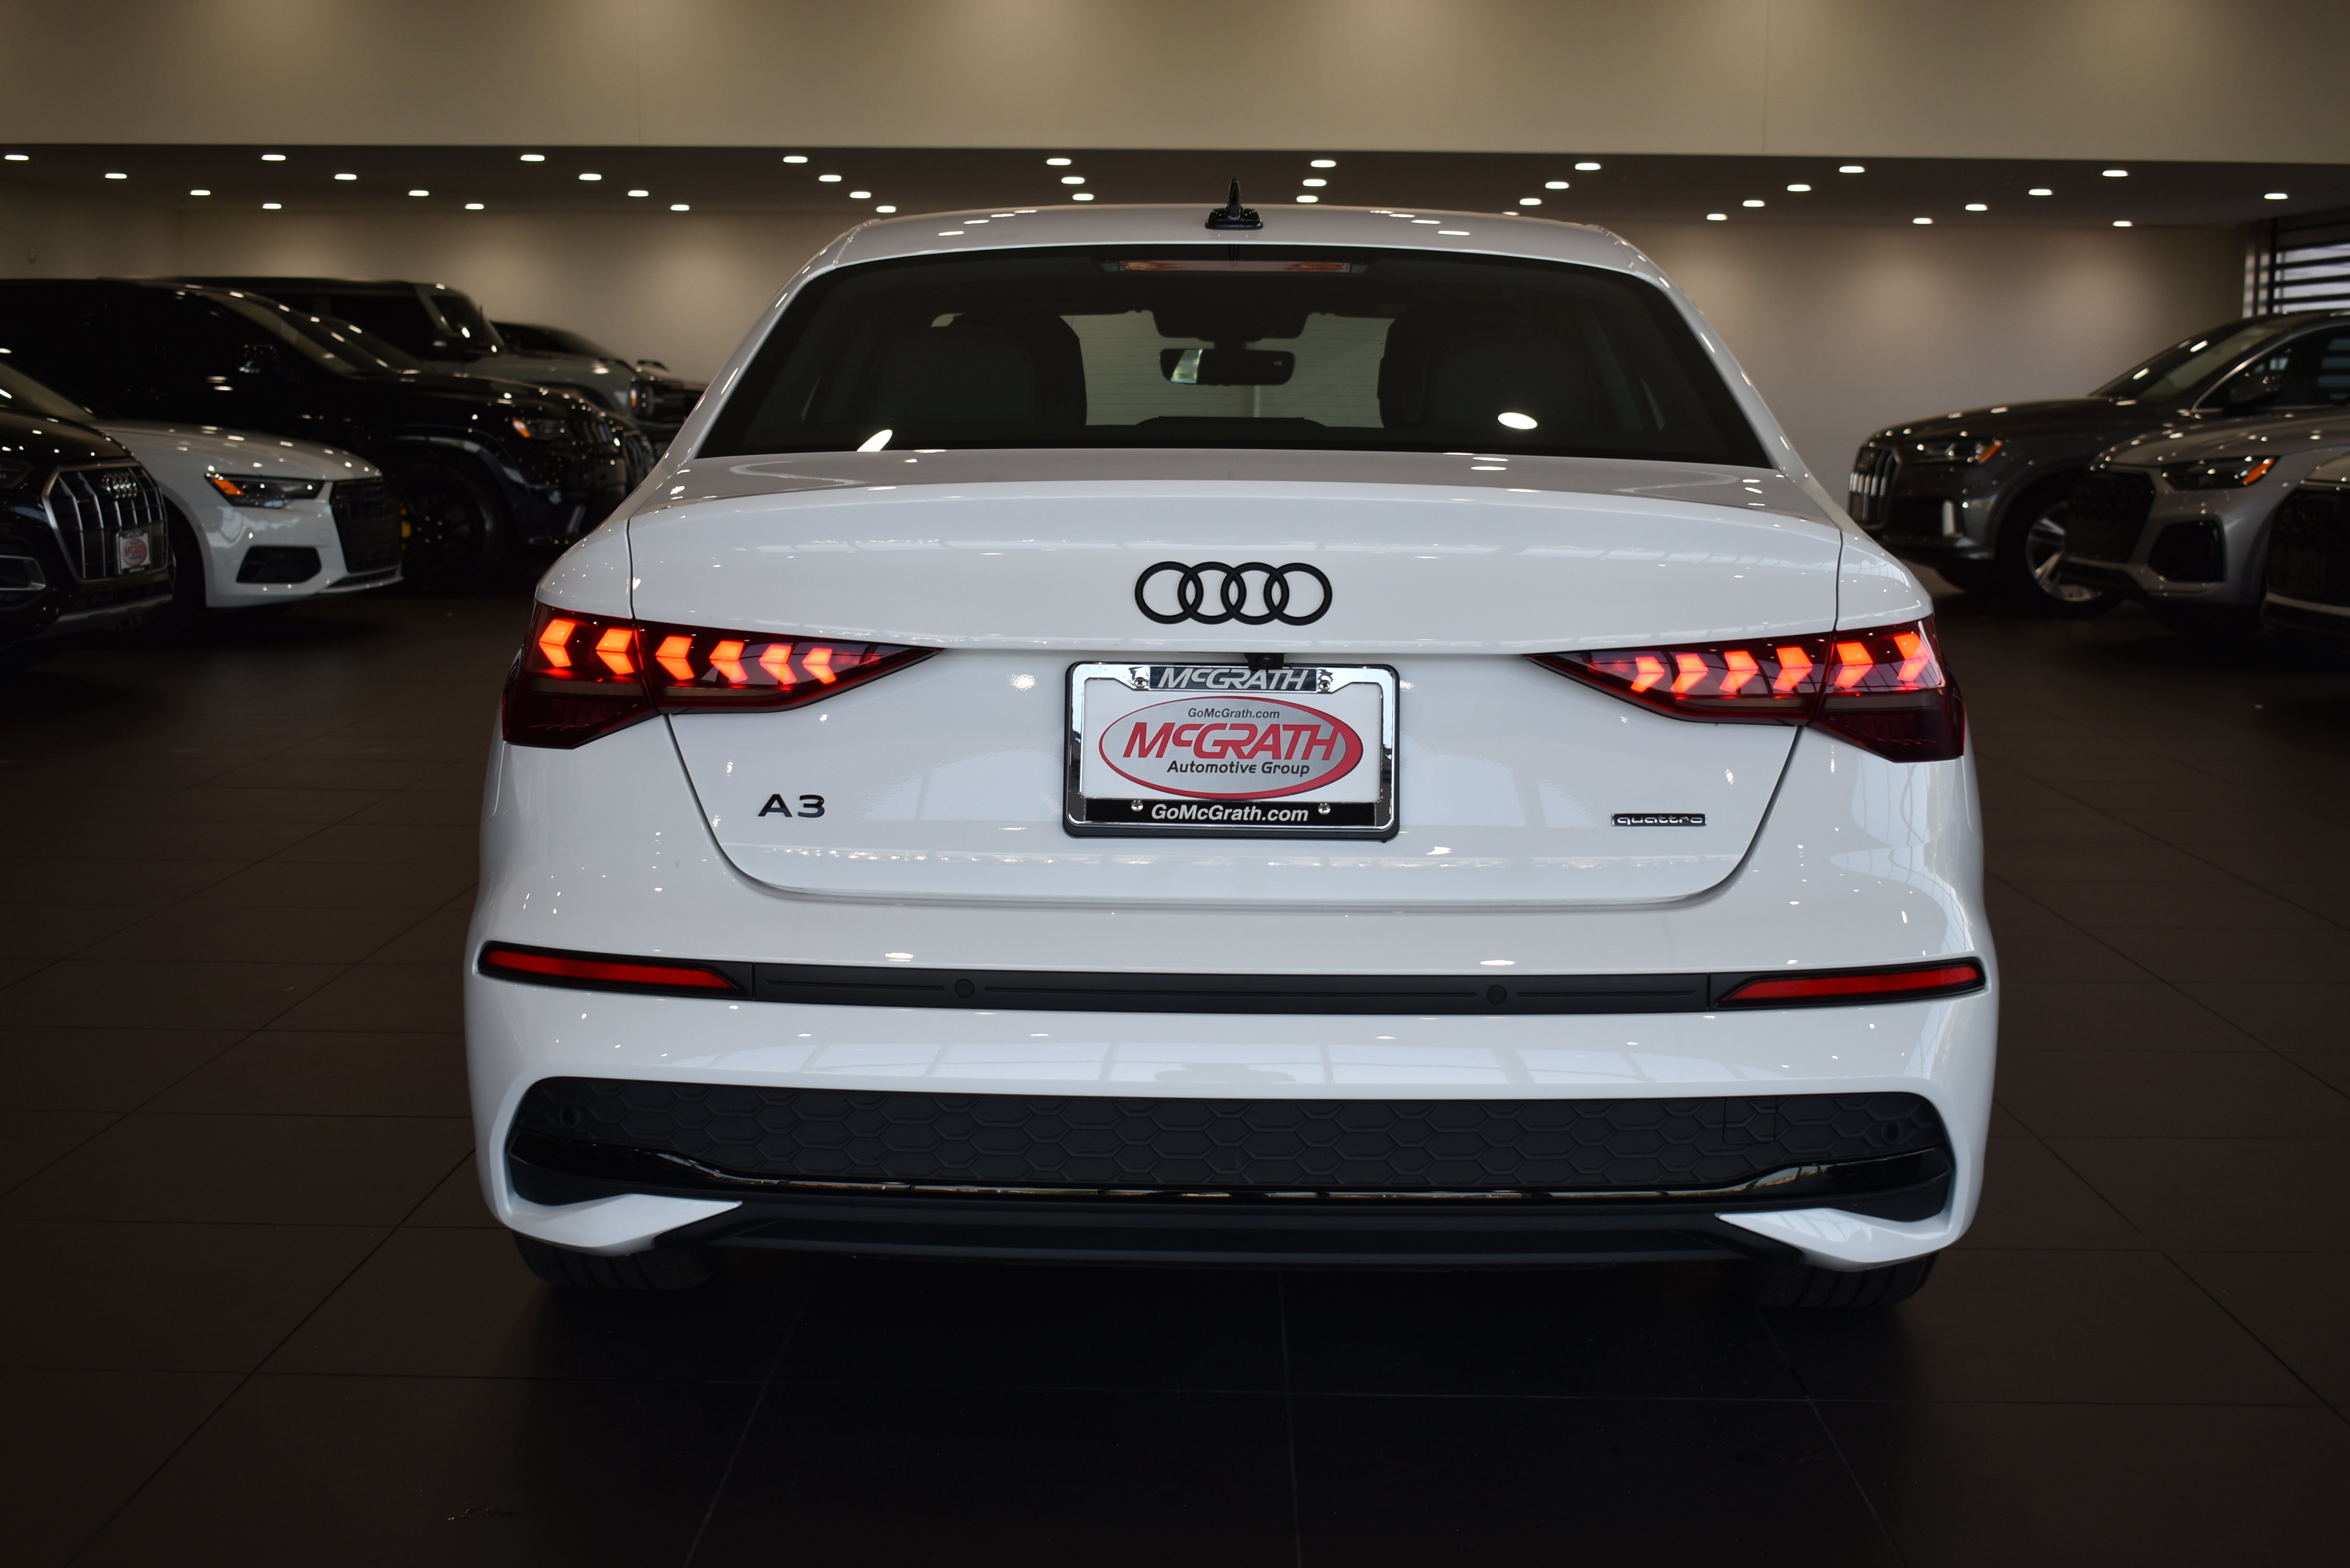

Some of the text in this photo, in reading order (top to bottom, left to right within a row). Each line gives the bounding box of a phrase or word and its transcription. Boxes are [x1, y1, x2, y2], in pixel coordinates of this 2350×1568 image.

[1188, 707, 1280, 719] GoMcGrath.com
[1166, 760, 1310, 777] Automotive Group
[757, 793, 825, 818] A3
[1151, 804, 1308, 822] GoMcGrath.com
[1617, 815, 1703, 825] quattro
